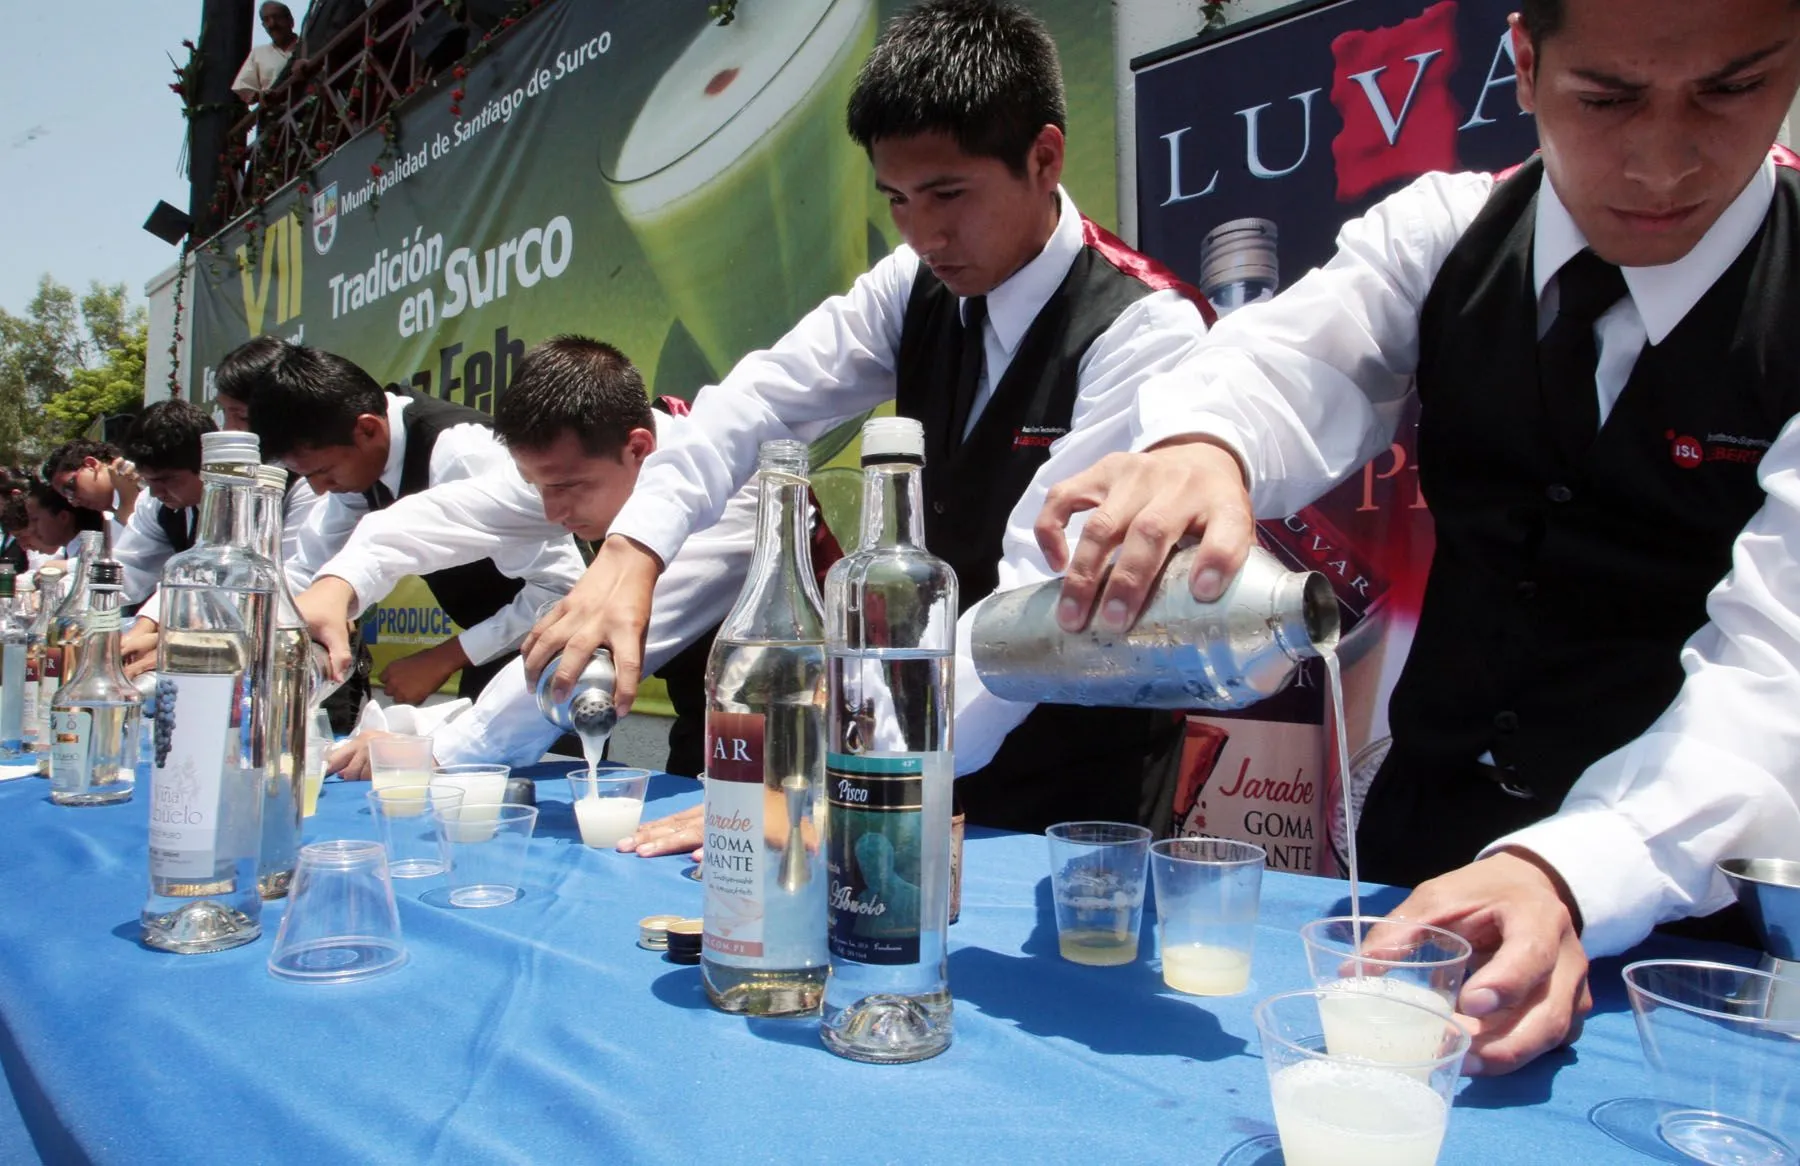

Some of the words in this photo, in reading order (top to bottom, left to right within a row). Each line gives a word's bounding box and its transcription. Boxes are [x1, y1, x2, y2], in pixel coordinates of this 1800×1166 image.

[341, 142, 428, 216] Municipalidad
[431, 133, 451, 159] de
[453, 87, 523, 147] Santiago
[527, 68, 551, 98] de
[555, 31, 612, 80] Surco
[328, 225, 444, 319] Tradición
[399, 287, 435, 338] en
[441, 215, 573, 318] Surco
[1675, 444, 1699, 459] ISL
[378, 607, 452, 635] PRODUCE
[838, 779, 868, 803] Pisco
[1219, 757, 1315, 804] Jarabe
[1244, 810, 1314, 840] GOMA
[709, 832, 754, 854] GOMA
